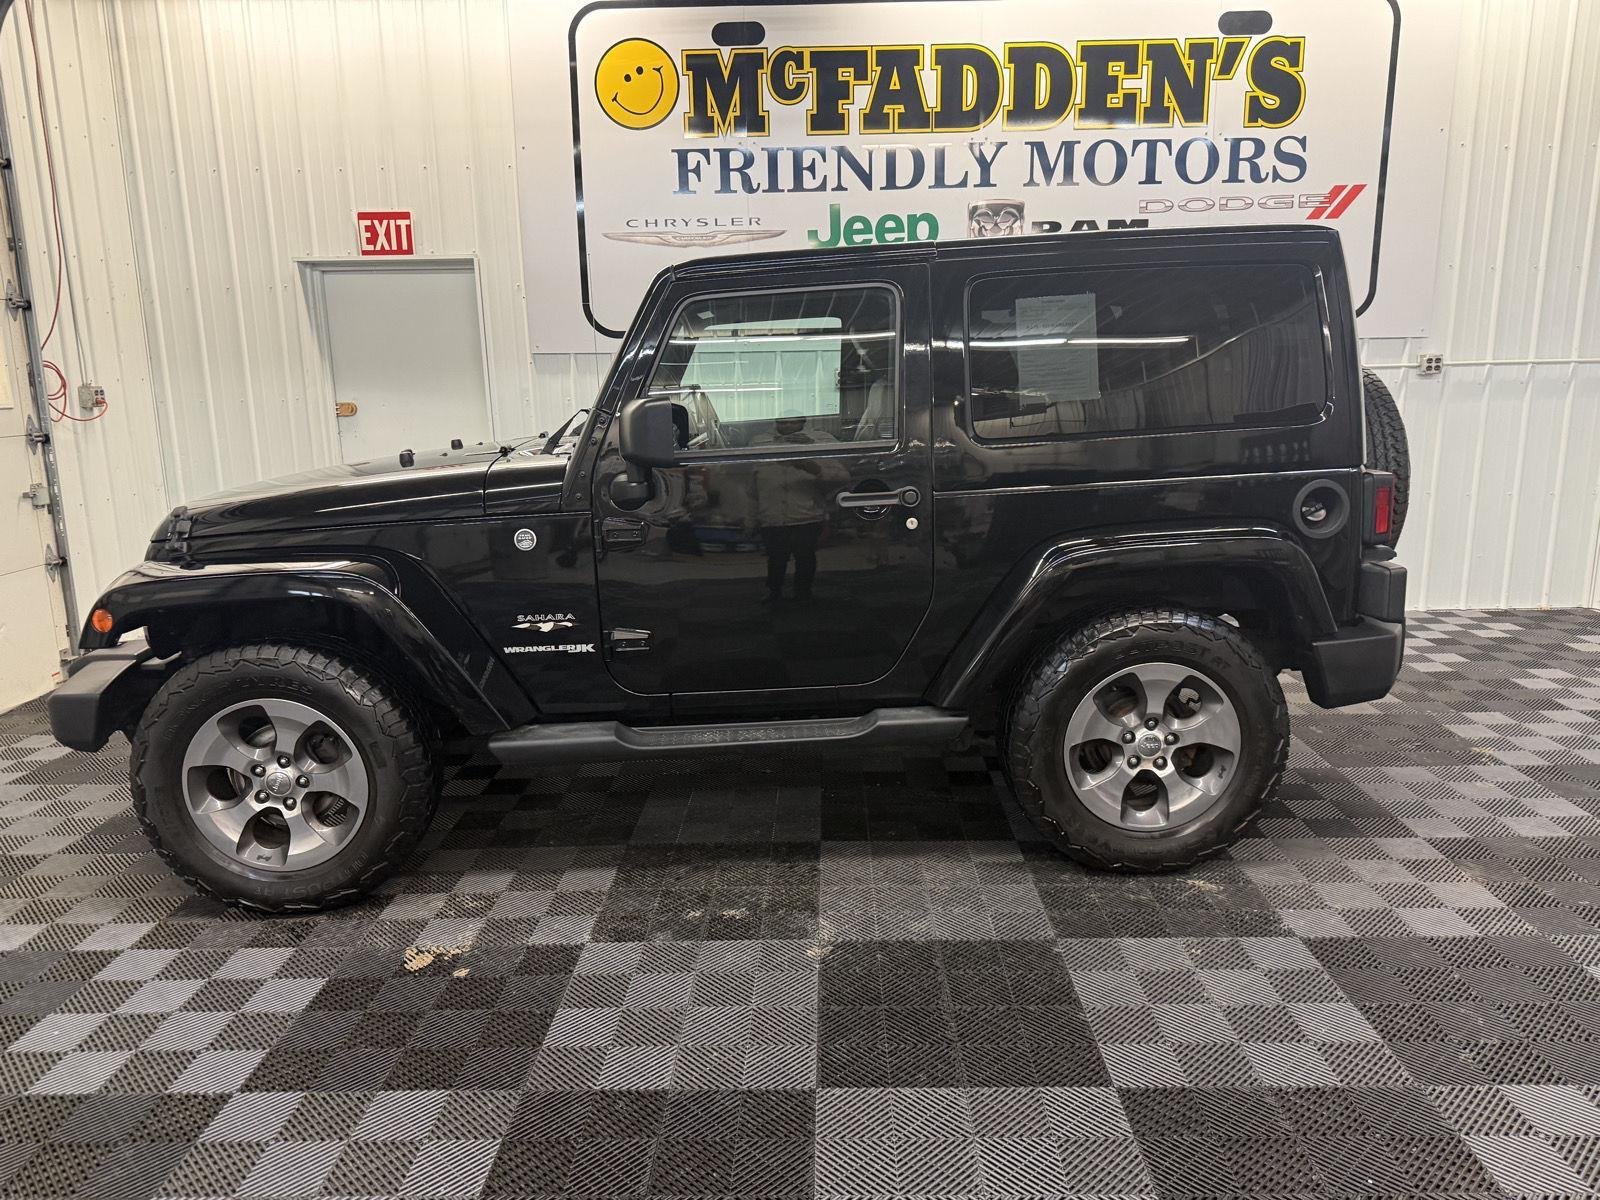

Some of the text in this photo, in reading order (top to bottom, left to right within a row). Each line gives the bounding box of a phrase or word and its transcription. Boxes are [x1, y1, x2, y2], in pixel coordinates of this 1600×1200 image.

[671, 135, 1308, 195] FRIENDLY MOTORS
[1139, 193, 1331, 214] DODGE
[359, 219, 411, 251] EXIT
[626, 217, 762, 229] CHRYSLER
[807, 203, 940, 248] Jeep
[516, 613, 576, 622] SAHARA
